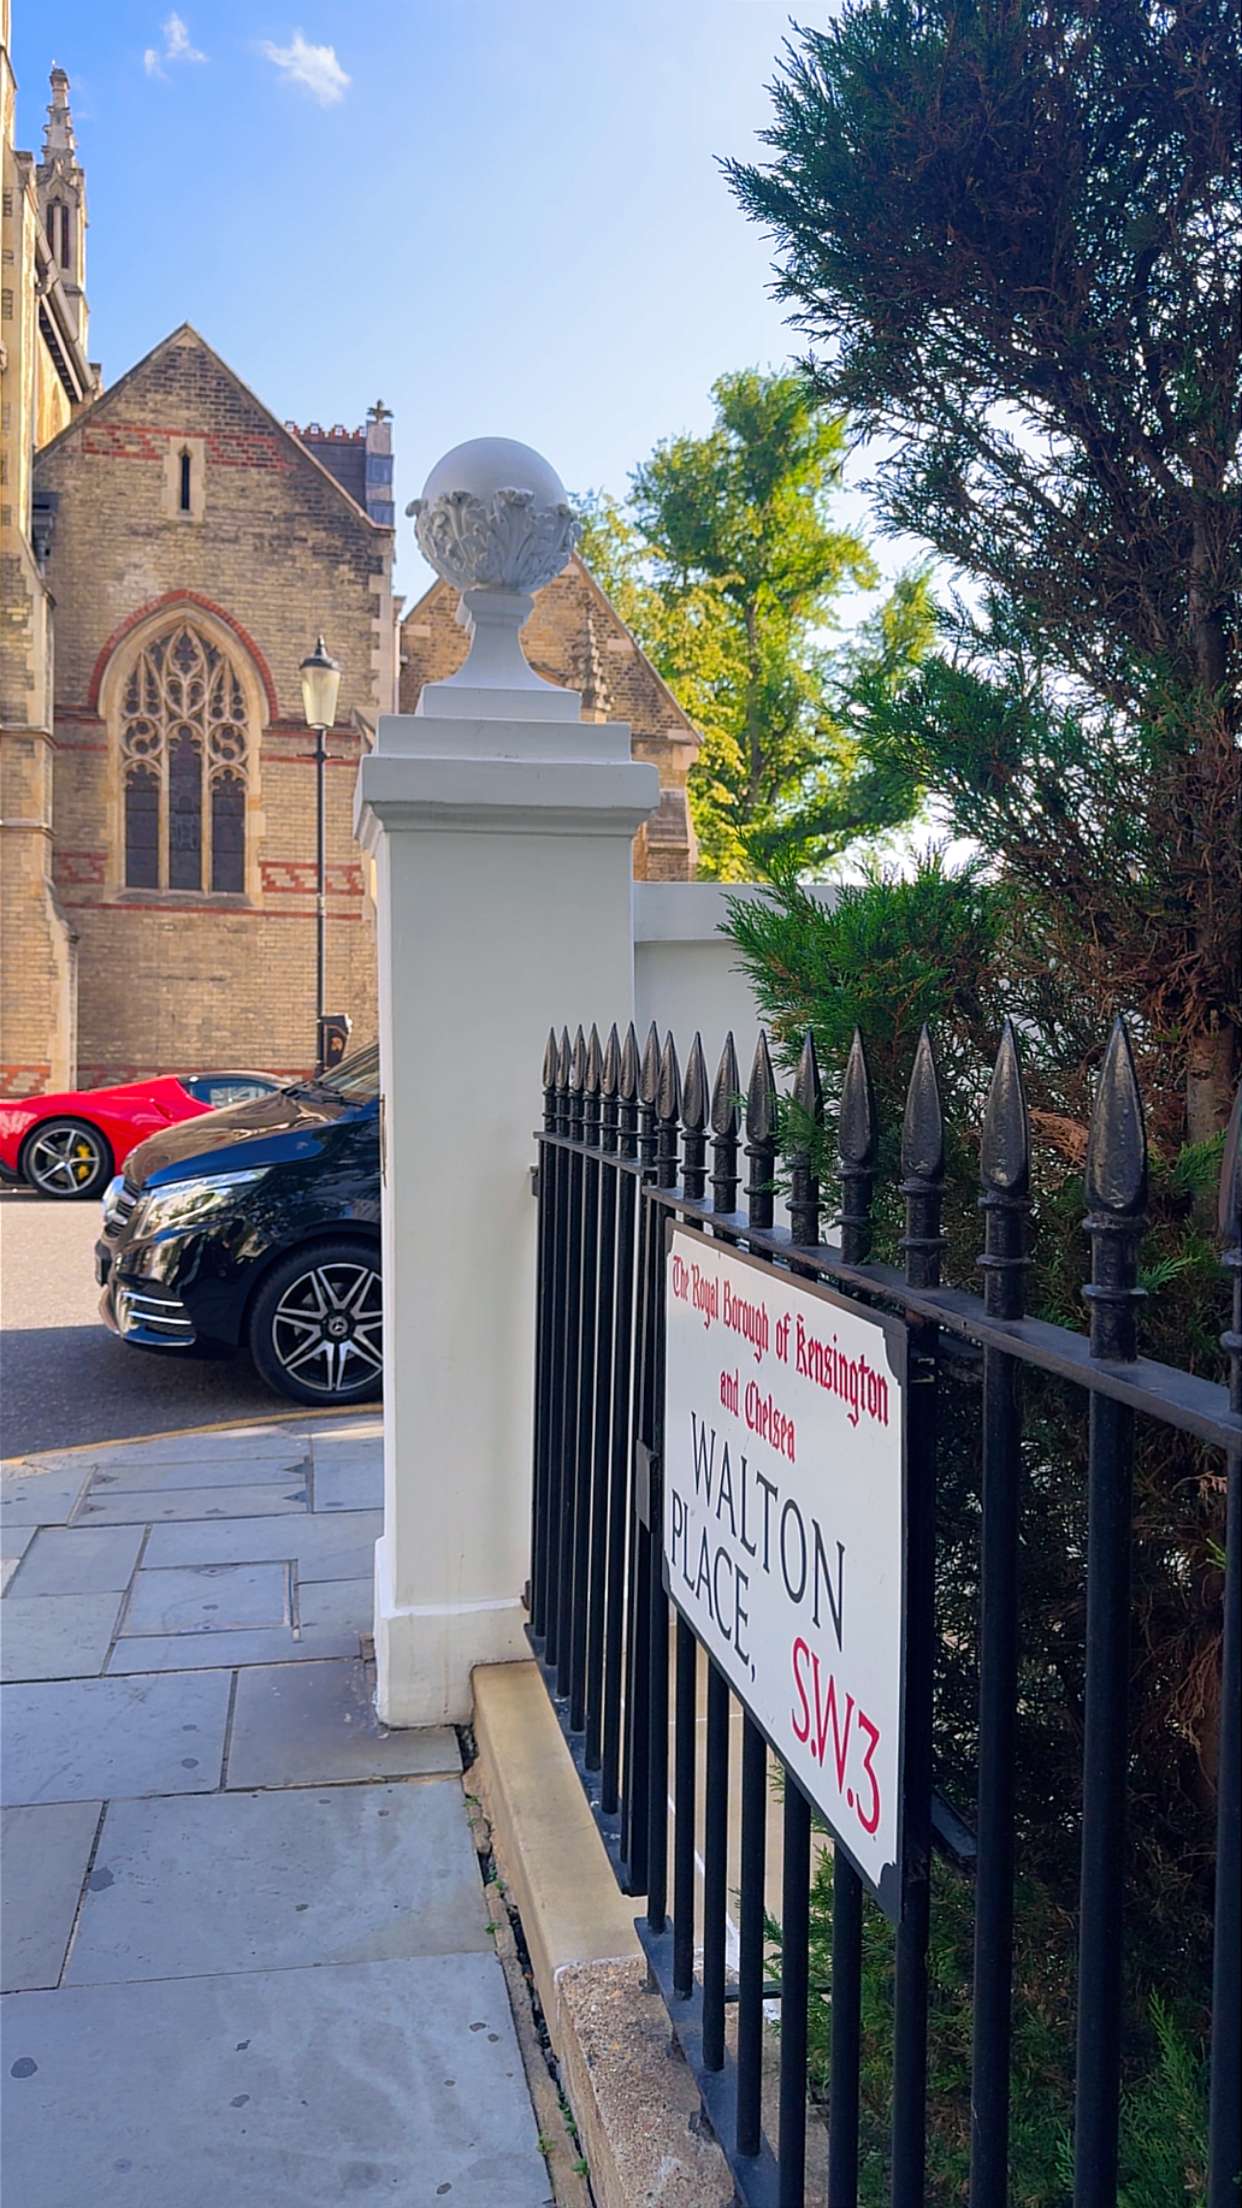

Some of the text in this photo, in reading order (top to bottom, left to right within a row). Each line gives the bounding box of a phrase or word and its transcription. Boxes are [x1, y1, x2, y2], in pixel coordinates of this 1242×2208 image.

[673, 1255, 889, 1427] The Royal Borough of Kensington
[720, 1368, 795, 1463] and Chelsea
[691, 1411, 845, 1653] WALTON
[671, 1488, 881, 1834] PLACE, S.W.3
